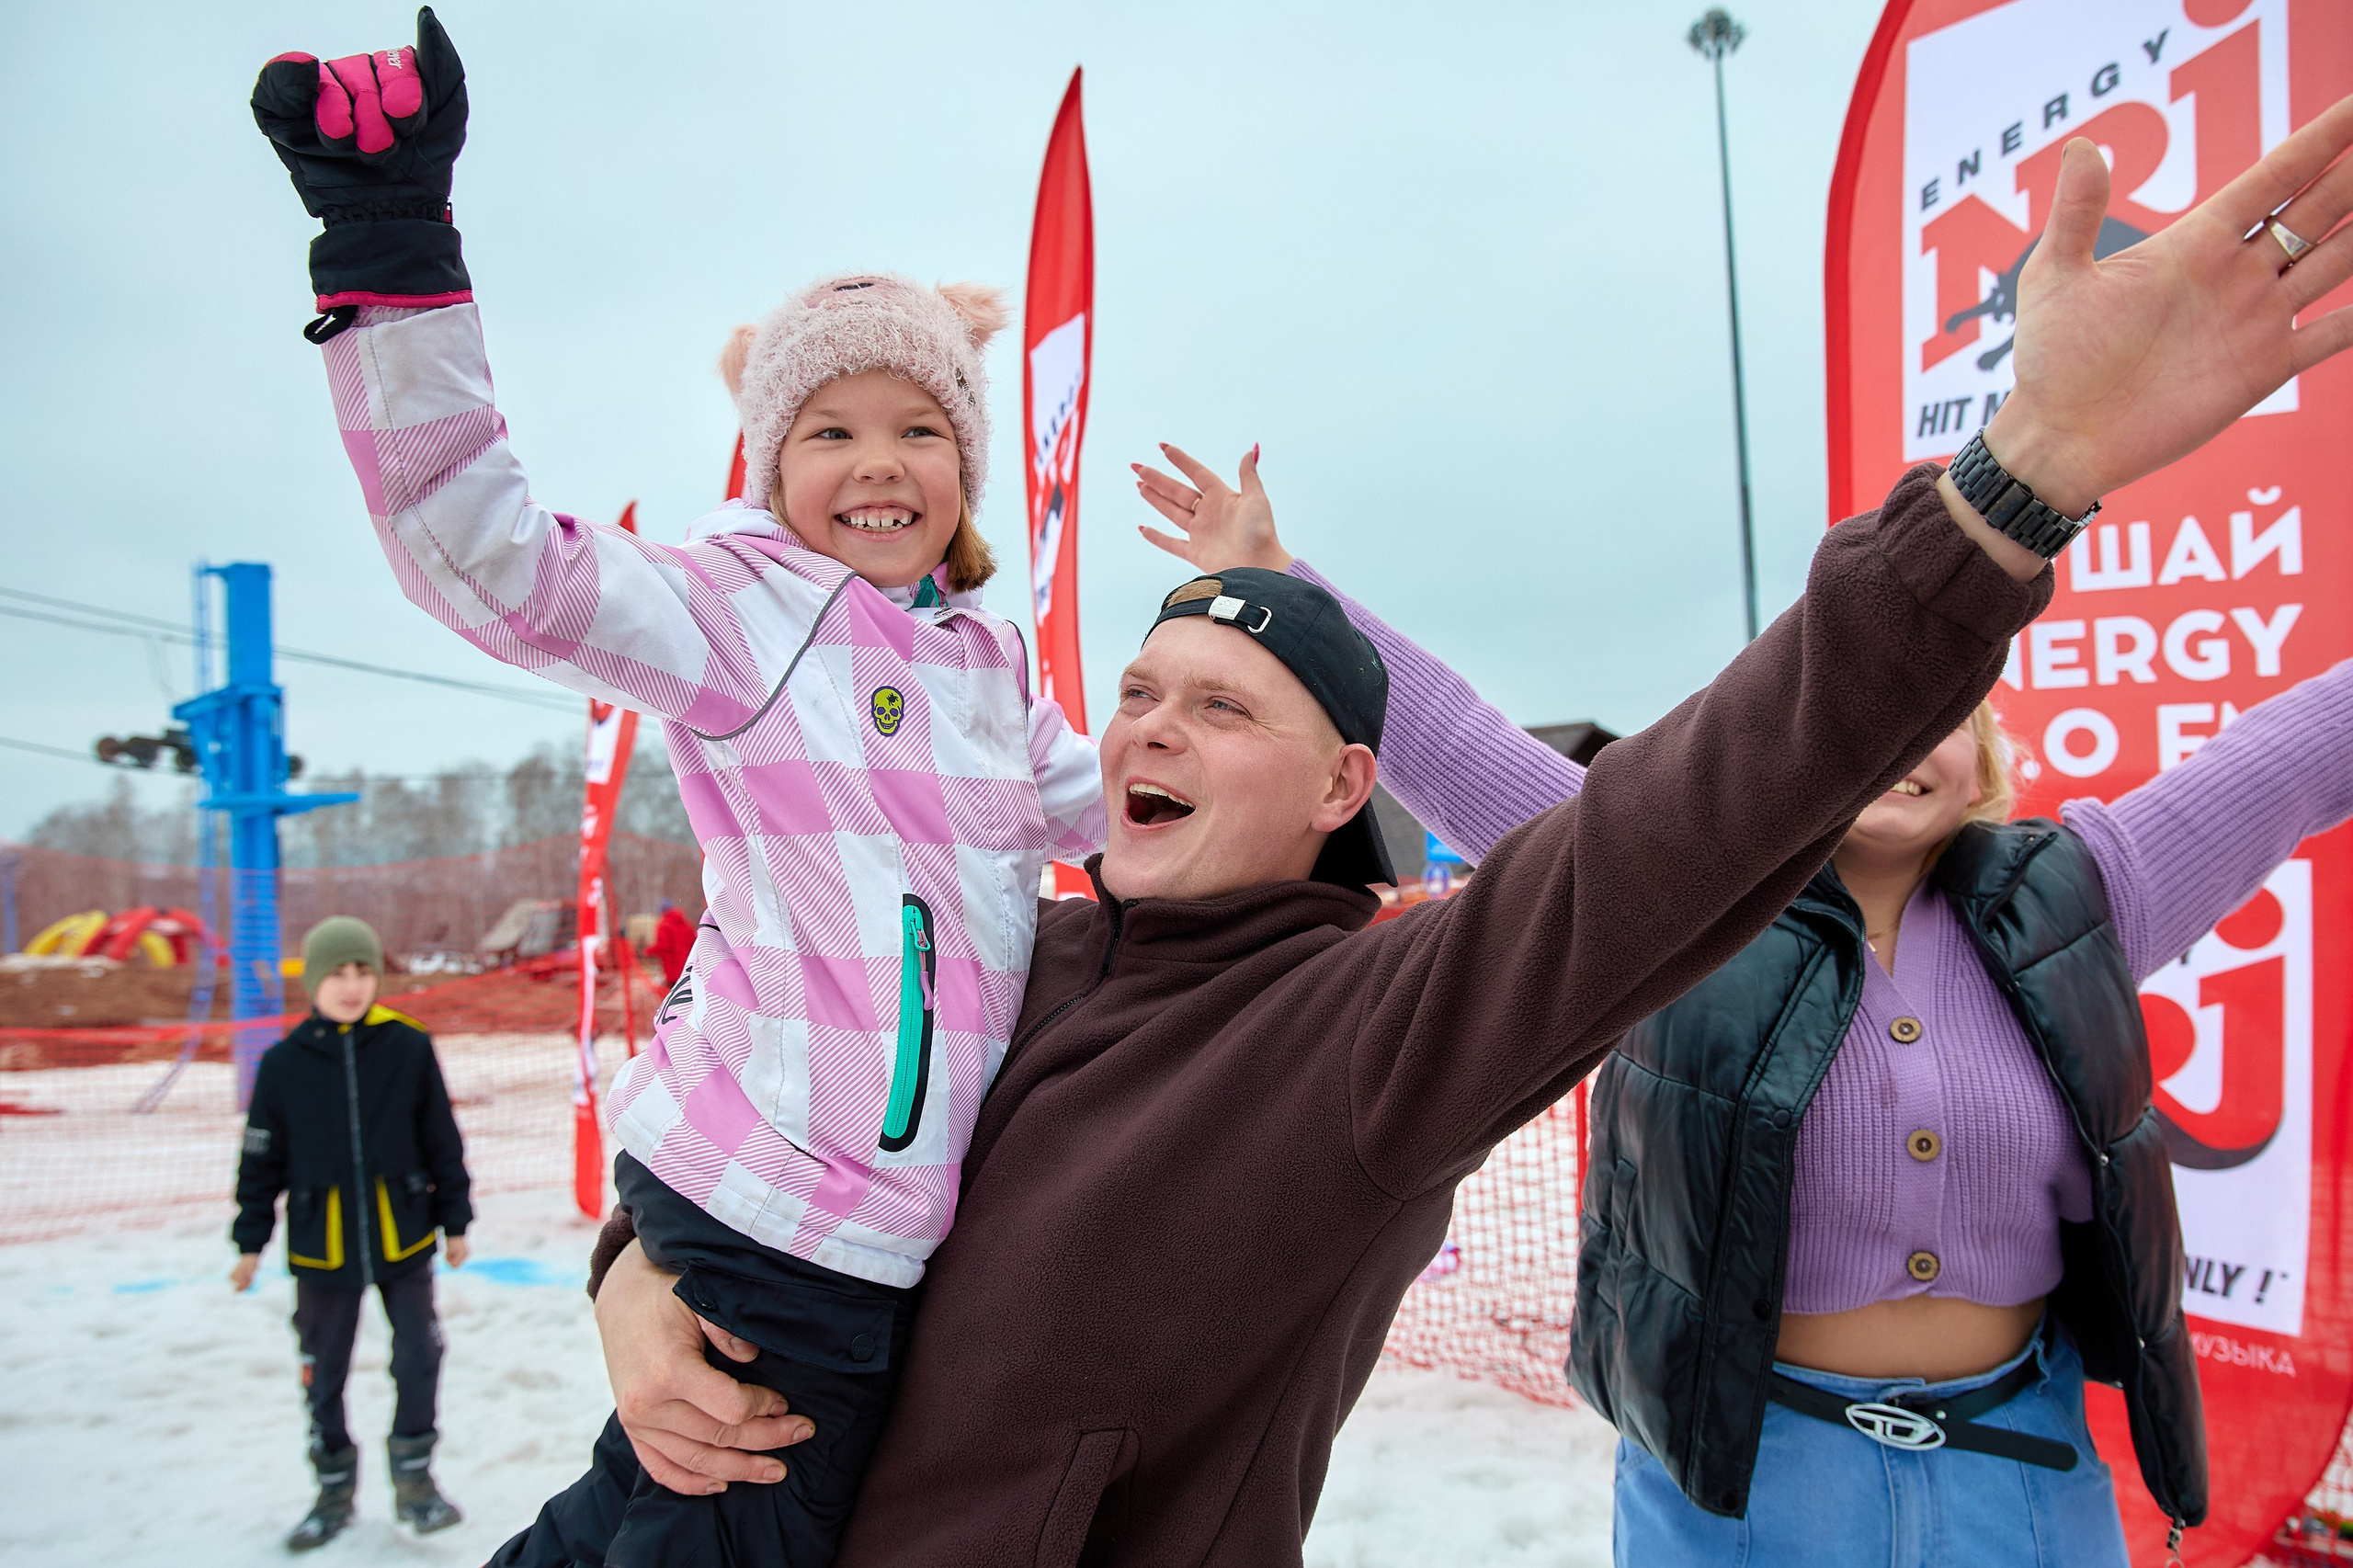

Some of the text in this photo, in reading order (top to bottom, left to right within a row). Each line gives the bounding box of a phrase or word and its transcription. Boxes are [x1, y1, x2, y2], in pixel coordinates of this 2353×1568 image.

[1920, 27, 2172, 211] ENERGY
[1917, 397, 1972, 437] HIT
[2069, 485, 2304, 593] ШАЙ
